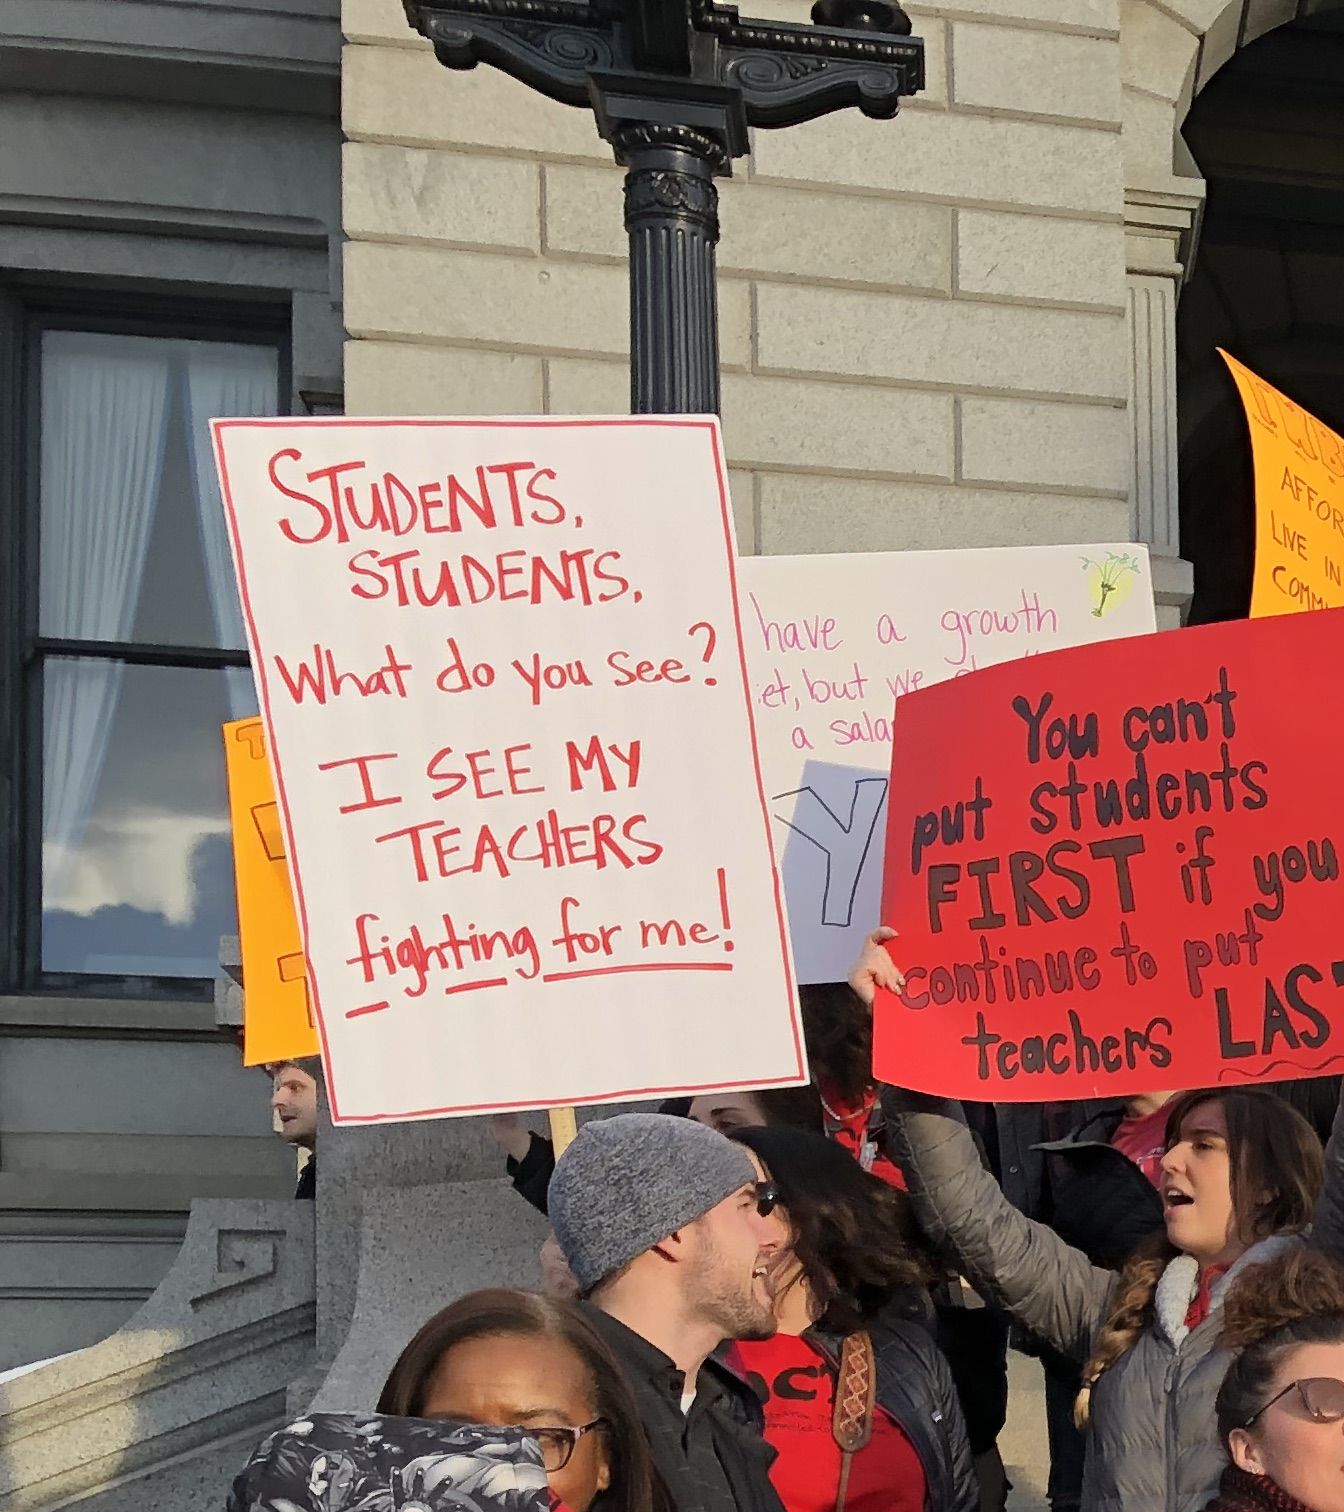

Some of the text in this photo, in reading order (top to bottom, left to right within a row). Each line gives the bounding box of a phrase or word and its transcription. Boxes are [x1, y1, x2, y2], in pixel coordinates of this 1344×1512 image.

[1270, 509, 1342, 587] LIVE IN
[748, 589, 1059, 666] have a growth
[274, 644, 412, 704] What
[436, 638, 494, 692] do
[511, 658, 592, 705] you
[802, 663, 924, 703] but we
[791, 711, 896, 750] a sala
[1011, 692, 1100, 764] You
[1123, 666, 1239, 753] can't
[318, 735, 641, 814] I SEE MY
[911, 742, 1270, 876] put students
[376, 809, 663, 882] TEACHERS
[926, 826, 1341, 934] FIRST if you
[346, 912, 541, 997] fighting
[541, 896, 623, 964] for
[639, 867, 735, 952] me!
[900, 908, 1264, 1011] continue to put
[961, 1009, 1175, 1082] teachers
